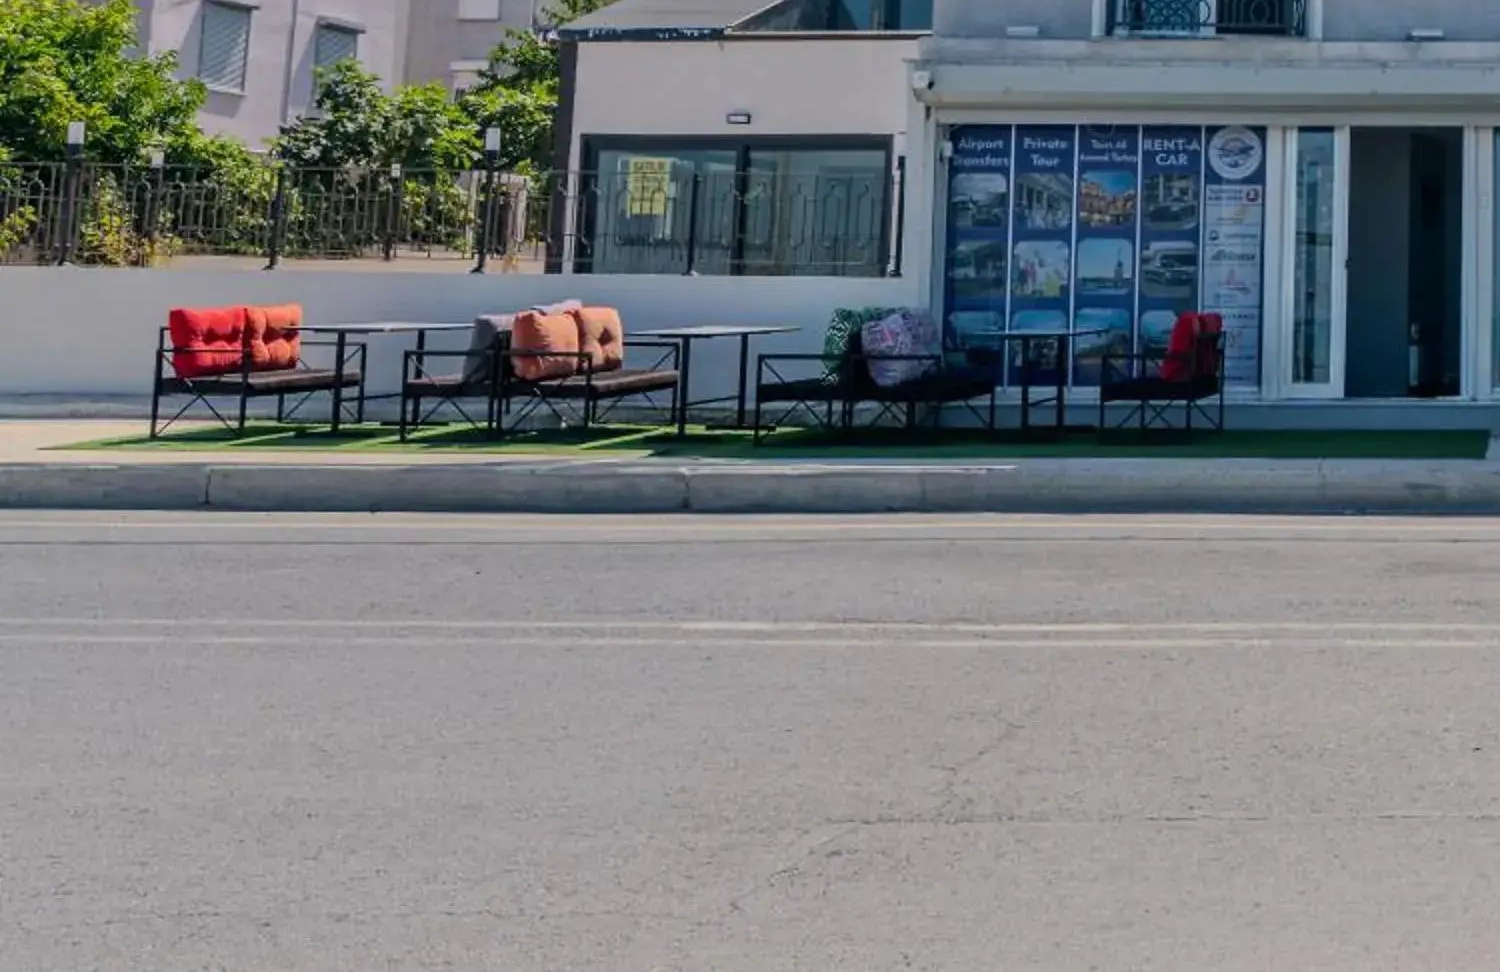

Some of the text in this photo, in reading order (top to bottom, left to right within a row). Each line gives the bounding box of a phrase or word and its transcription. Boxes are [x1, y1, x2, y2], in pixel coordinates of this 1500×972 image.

[958, 136, 1003, 152] Airport
[1023, 137, 1068, 149] Private
[1030, 153, 1060, 167] Tour
[1155, 153, 1188, 166] CAR
